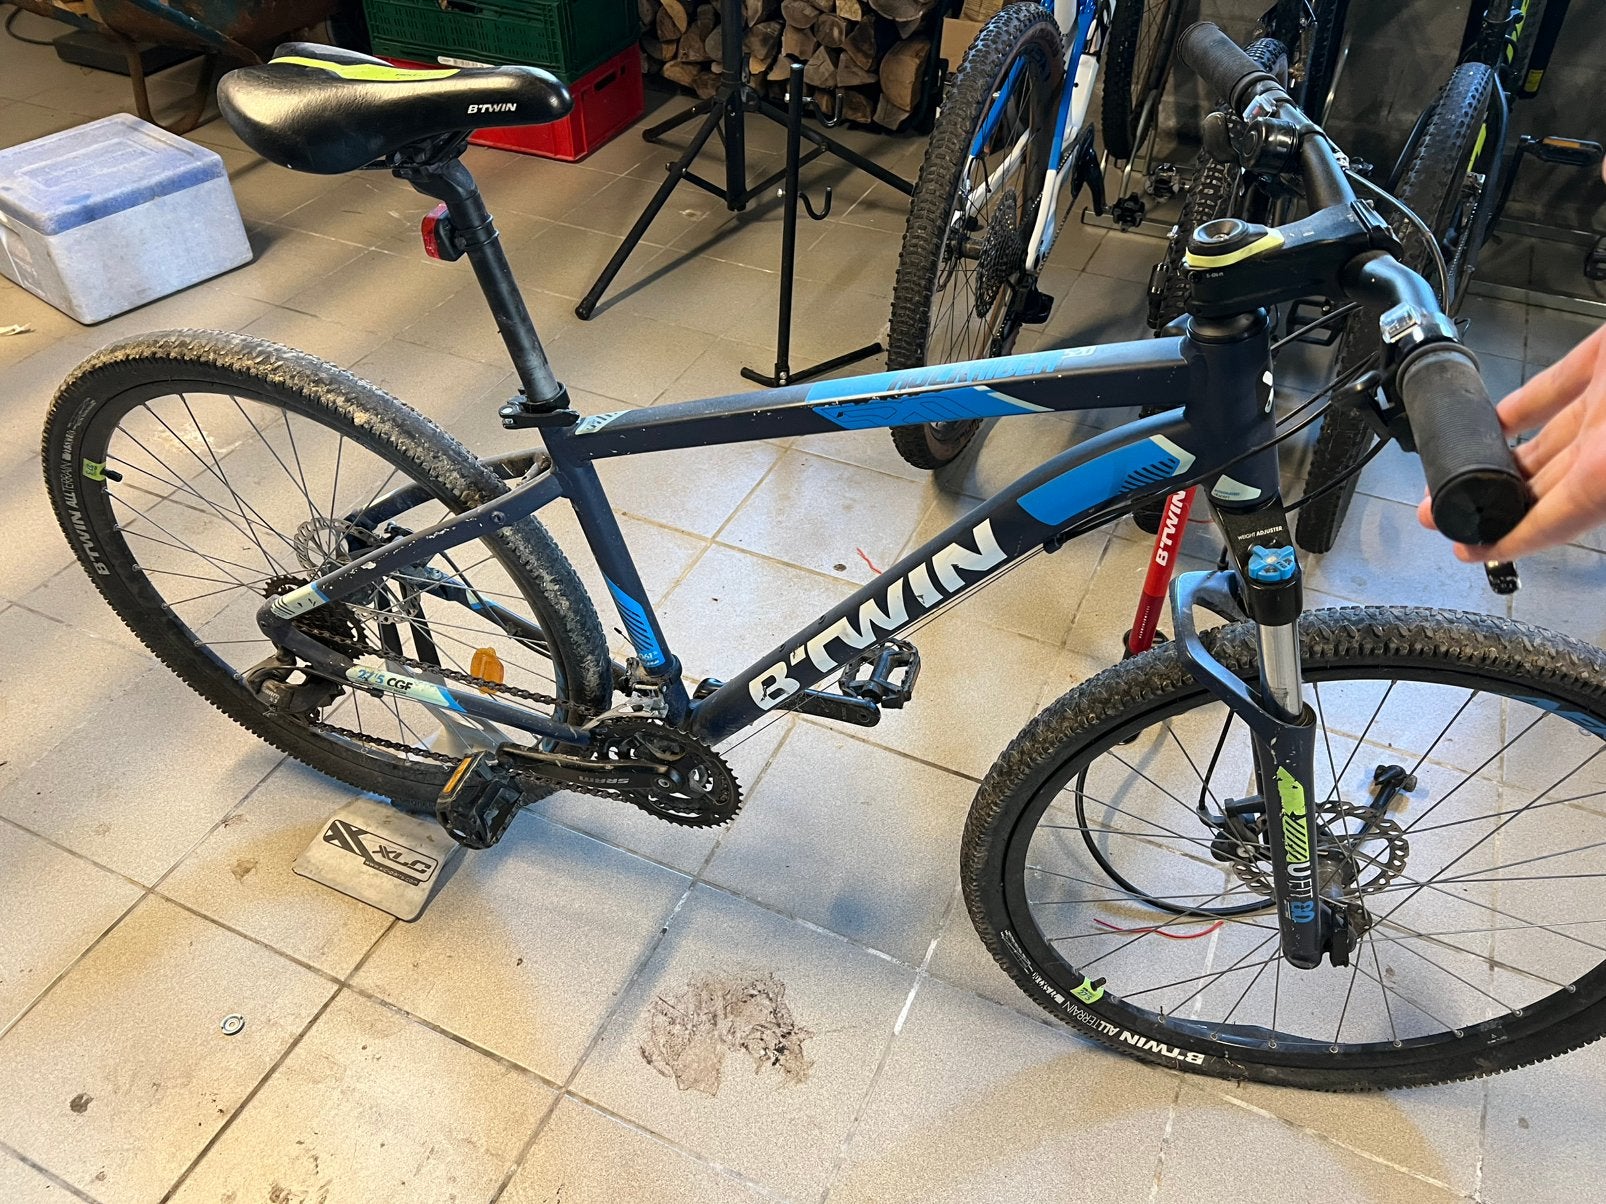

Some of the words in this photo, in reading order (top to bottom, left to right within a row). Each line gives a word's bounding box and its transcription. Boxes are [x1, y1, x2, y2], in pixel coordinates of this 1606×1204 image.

[1237, 532, 1256, 540] WEIGHT
[1256, 525, 1283, 536] ADJUSTER
[748, 517, 1008, 711] B'TWIN
[371, 844, 432, 874] XLC
[1118, 1030, 1205, 1065] B'TWIN
